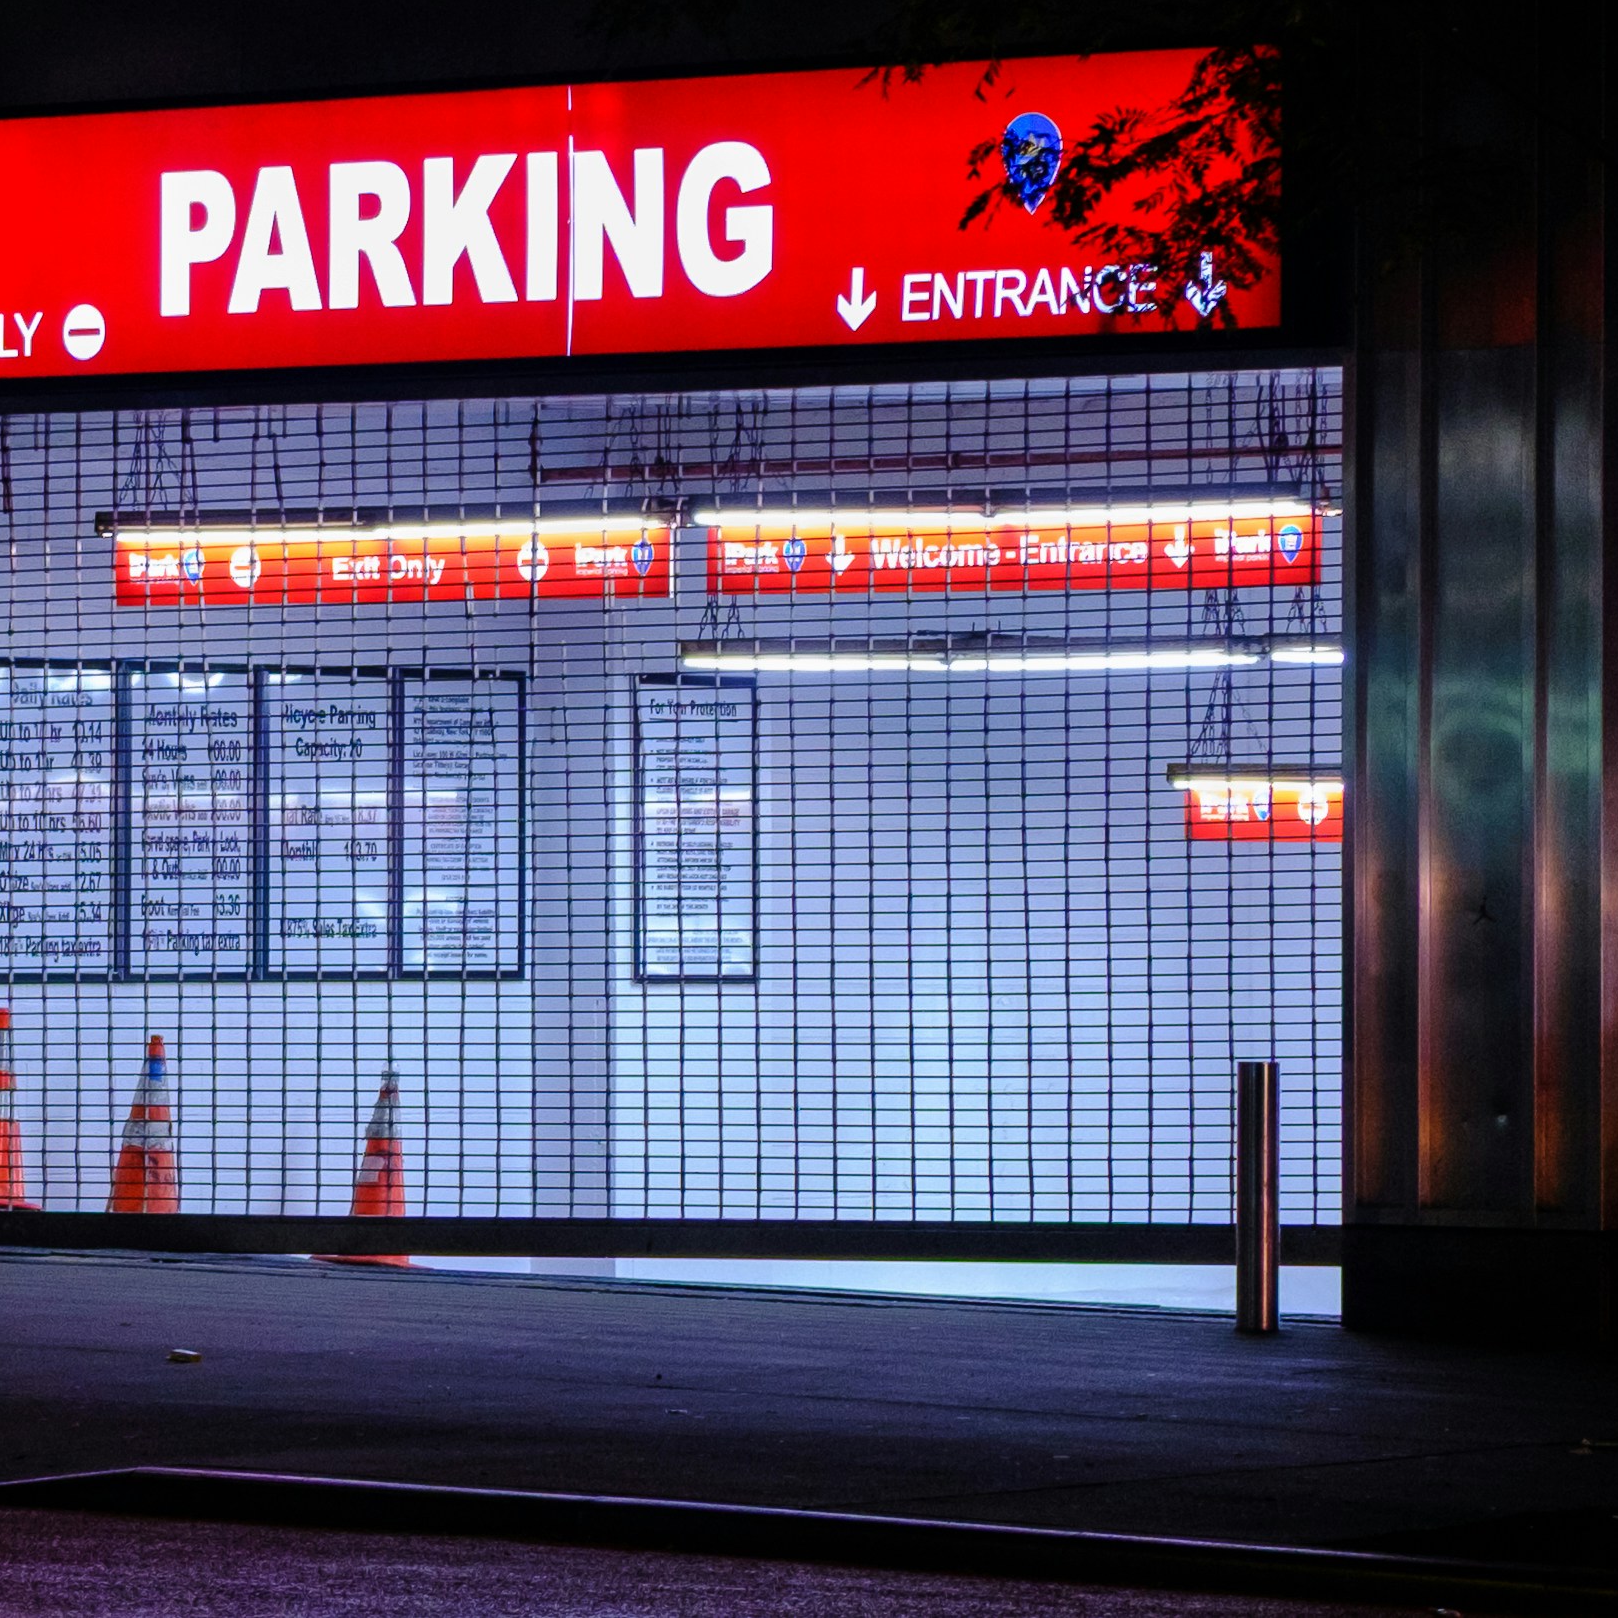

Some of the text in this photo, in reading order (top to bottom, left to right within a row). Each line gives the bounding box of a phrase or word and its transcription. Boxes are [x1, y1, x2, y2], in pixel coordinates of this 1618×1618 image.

[159, 136, 773, 317] PARKING
[901, 264, 1159, 323] ENTRANCE
[331, 556, 381, 580] Exit
[389, 554, 446, 585] Only
[870, 537, 1001, 570] Welcome
[1019, 534, 1149, 566] Entrance
